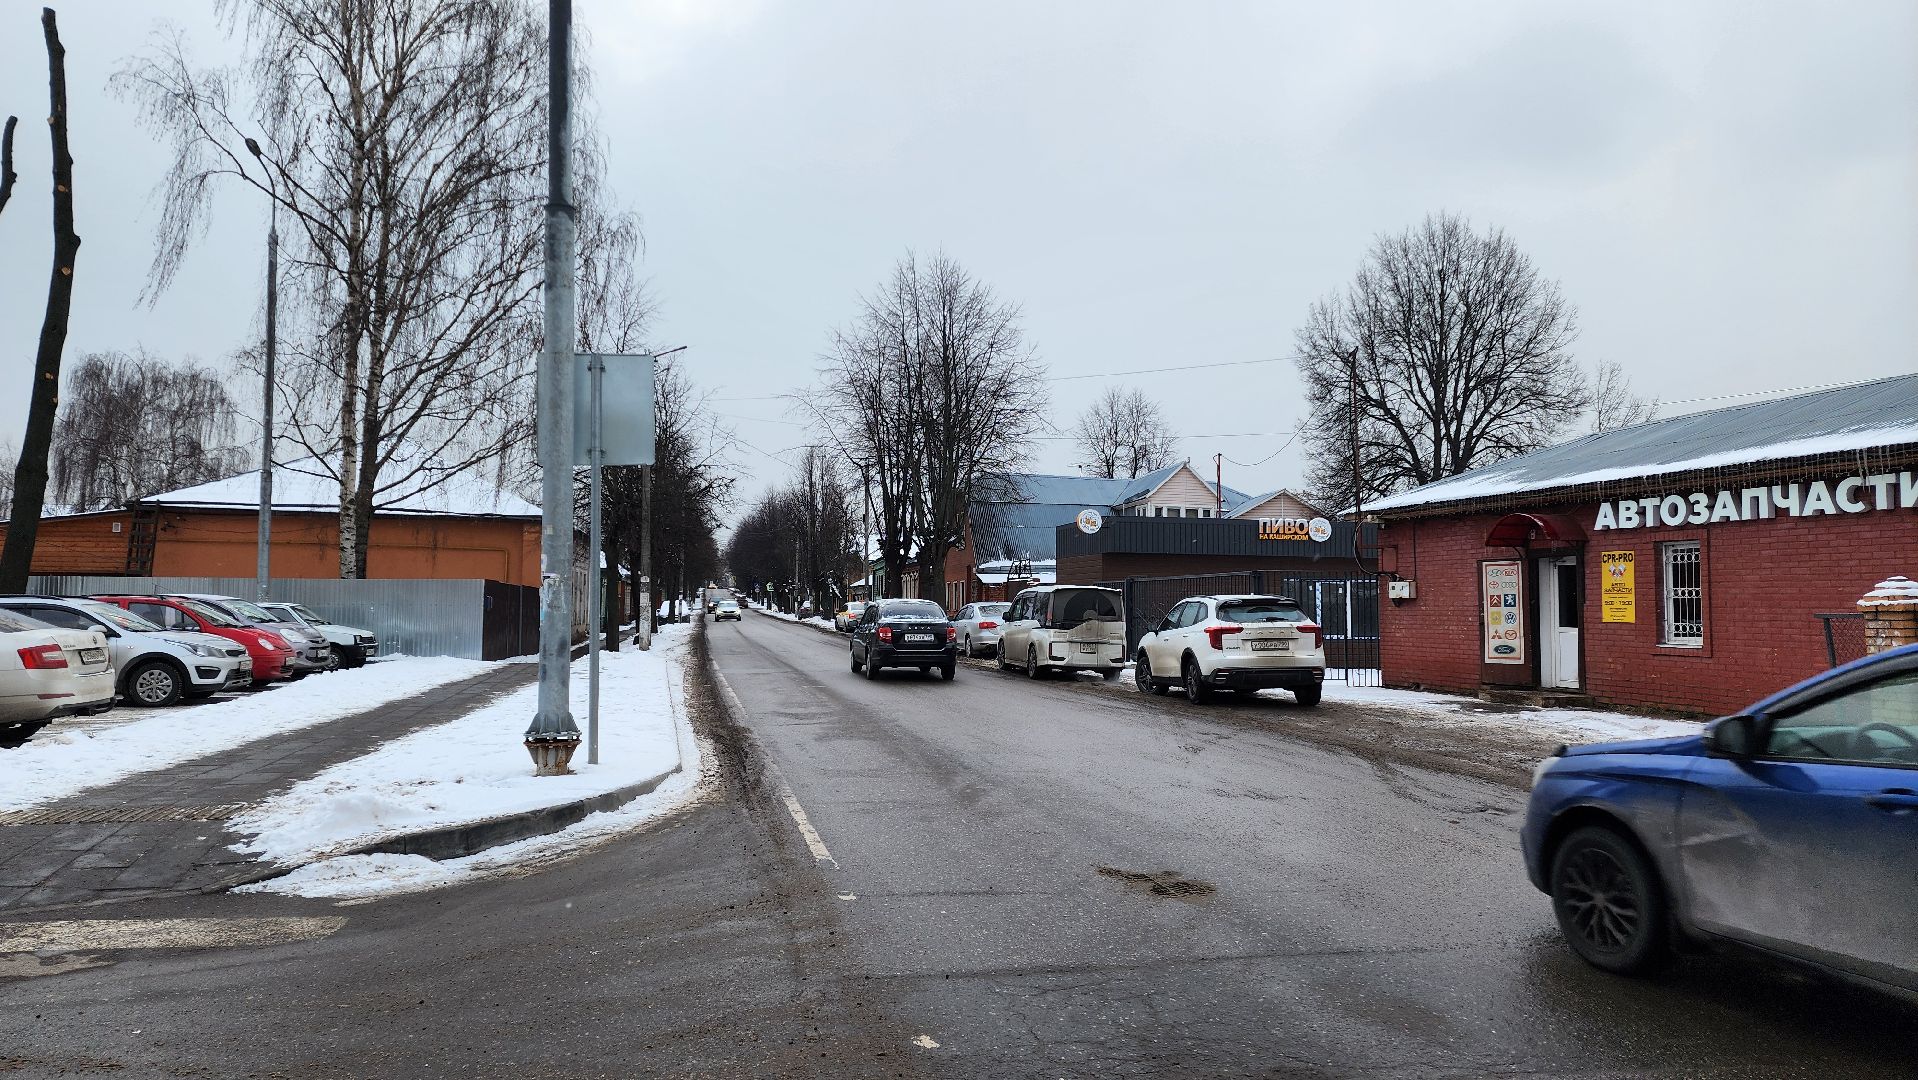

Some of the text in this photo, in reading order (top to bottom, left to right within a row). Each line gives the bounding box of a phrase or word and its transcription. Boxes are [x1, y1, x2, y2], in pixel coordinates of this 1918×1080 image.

[1593, 471, 1918, 531] АВТОЗАПЧАСТИ
[1258, 517, 1309, 534] ПИВО
[1602, 553, 1634, 563] CPR-PRO
